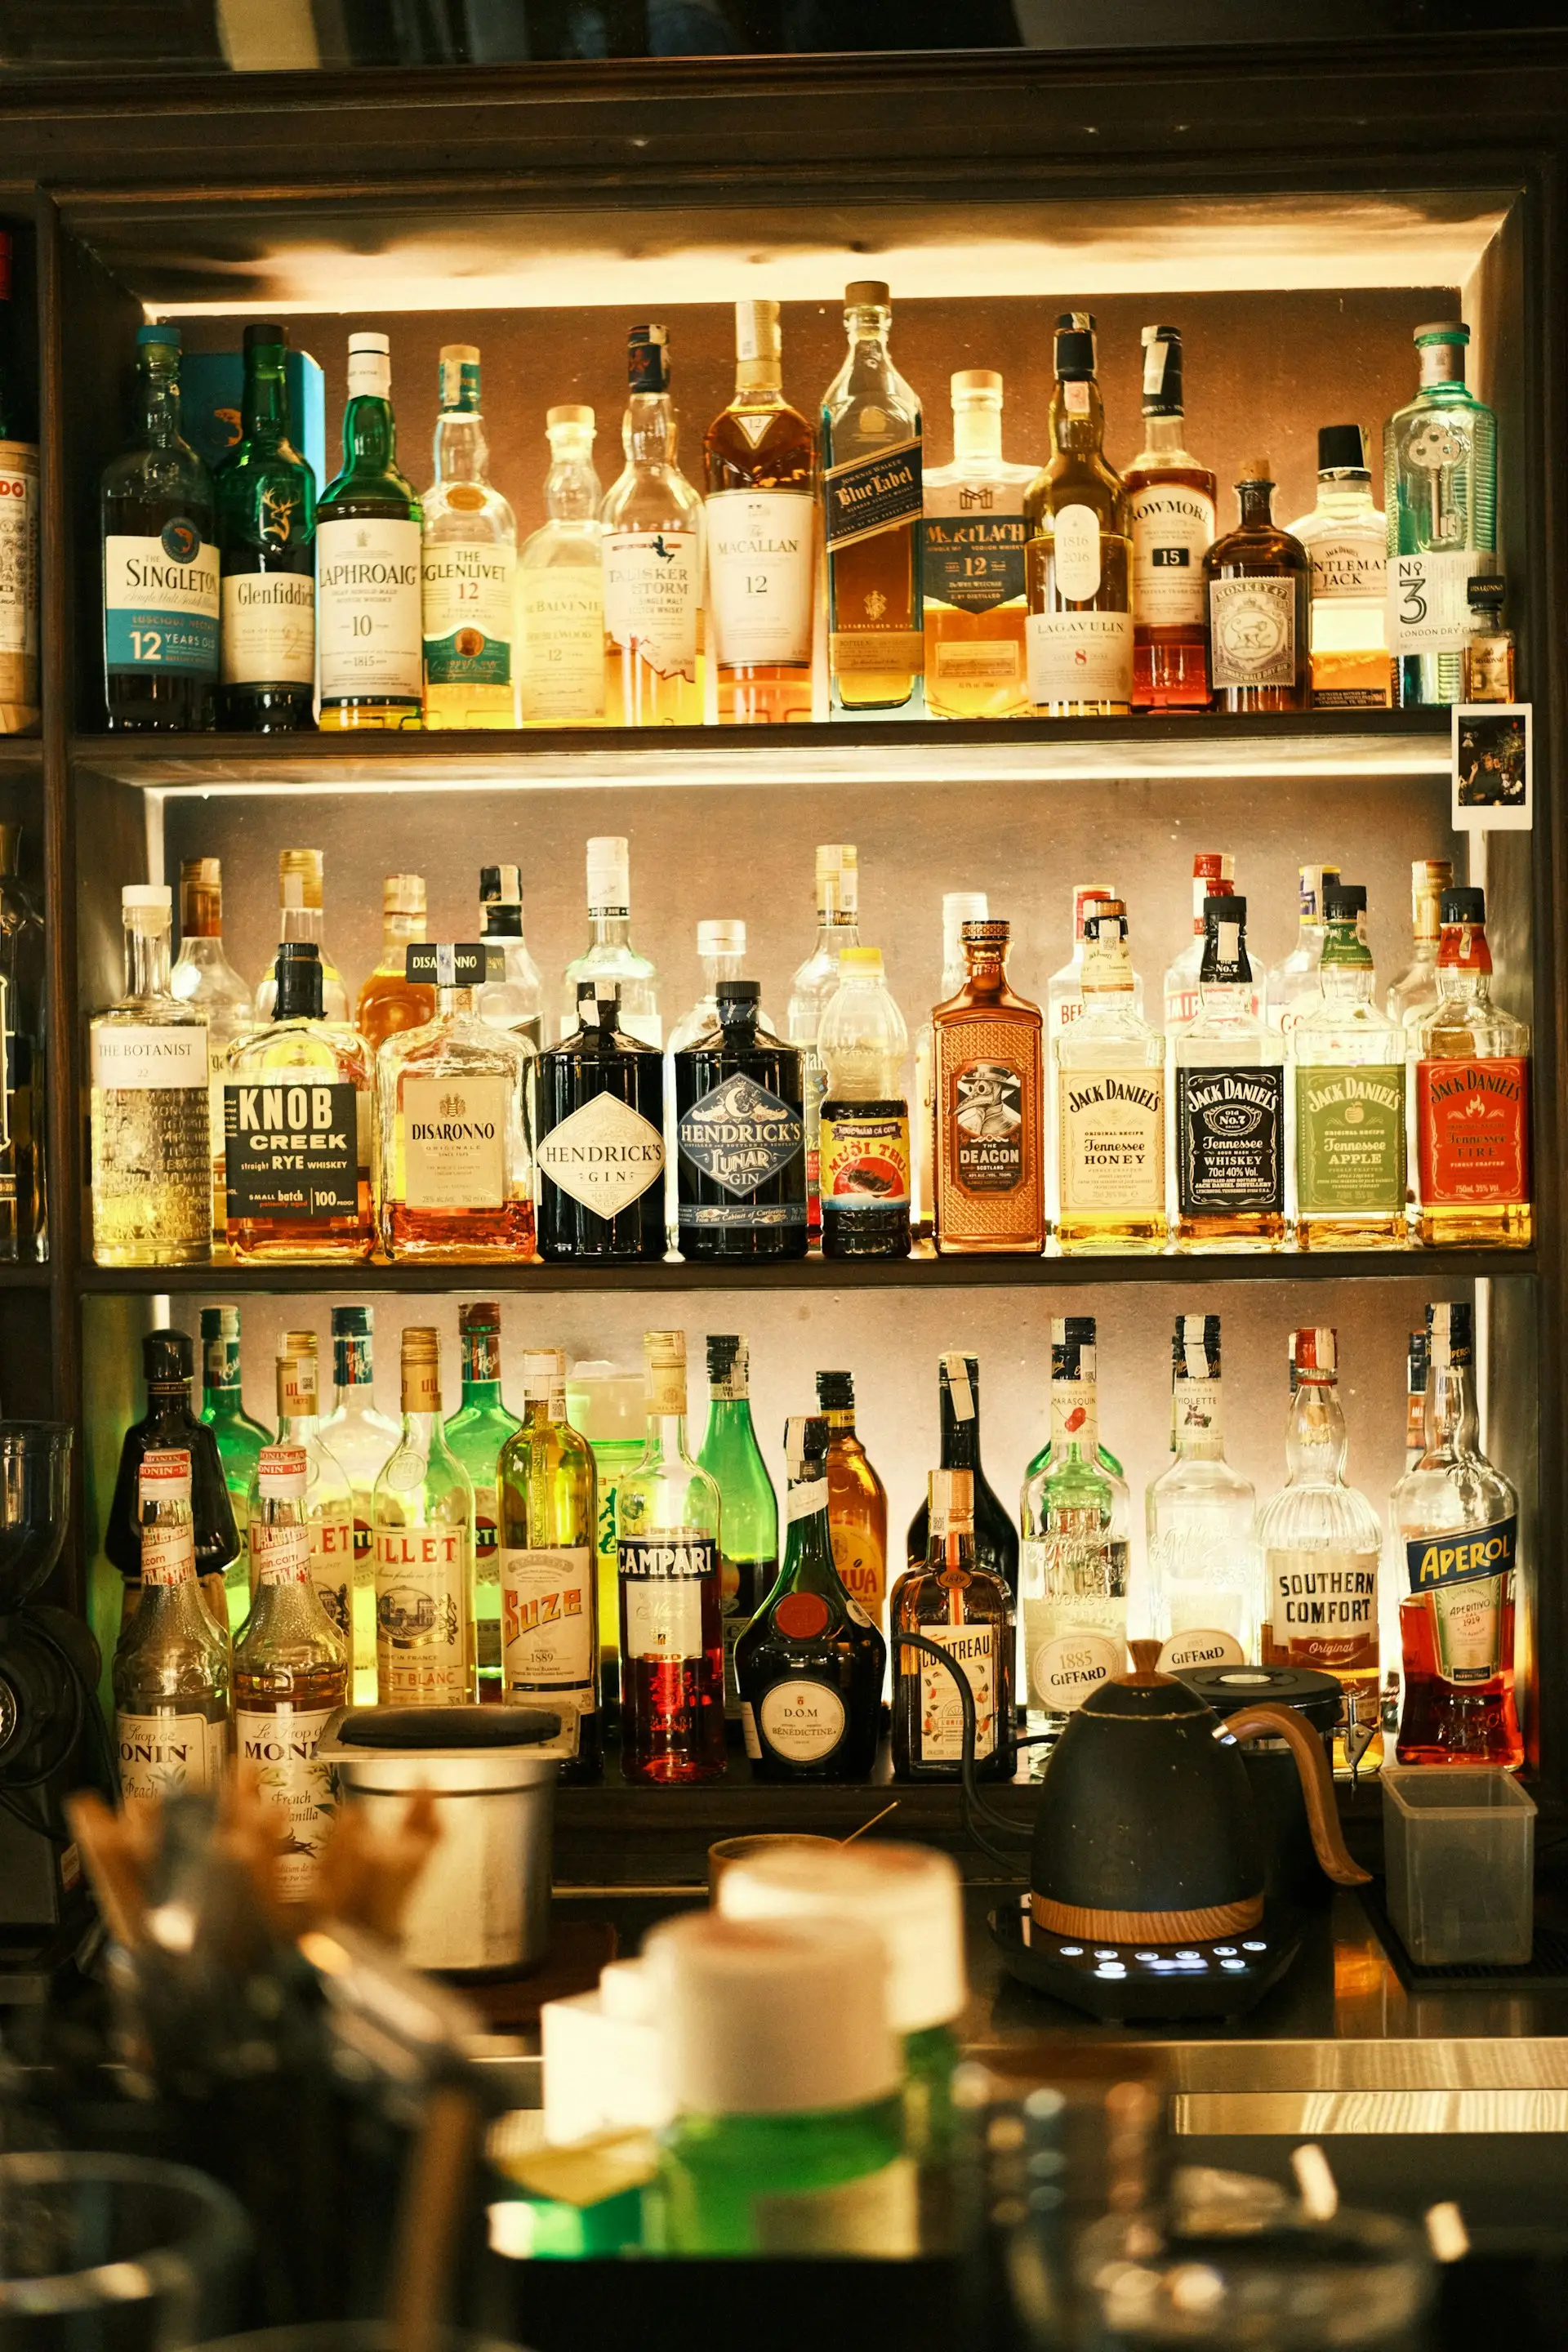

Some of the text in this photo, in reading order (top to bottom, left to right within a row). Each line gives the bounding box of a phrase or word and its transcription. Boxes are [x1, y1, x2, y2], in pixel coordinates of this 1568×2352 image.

[748, 417, 762, 429] 12
[841, 459, 902, 486] JOHNNIE WALKER
[835, 466, 913, 509] Blue Label
[717, 539, 800, 555] MACALLAN
[455, 550, 481, 562] THE
[1161, 550, 1180, 564] 15
[425, 564, 506, 582] GLENLIVET
[964, 556, 987, 577] 12
[608, 568, 688, 583] TALISKER
[1323, 572, 1363, 587] JACK
[457, 582, 479, 600] 12
[631, 581, 688, 595] STORM
[744, 575, 768, 595] 12
[1217, 582, 1287, 601] MONKEY 47
[666, 597, 683, 605] MALT
[1399, 577, 1428, 625] 3
[353, 614, 372, 637] 10
[1037, 621, 1125, 634] LAGAVULIN
[1399, 627, 1459, 638] LONDON DRY
[129, 630, 162, 661] 12
[165, 633, 199, 645] YEARS
[353, 656, 375, 667] 1815
[546, 648, 563, 662] 12
[1075, 648, 1088, 666] 8
[1263, 666, 1276, 677] DRY
[412, 956, 477, 969] DISANNO
[1215, 963, 1238, 973] No.7
[123, 1043, 193, 1057] BOTANIST
[137, 1068, 149, 1078] 22
[1429, 1069, 1523, 1104] JACK DANIEL'S
[1068, 1078, 1161, 1113] JACK DANIEL'S
[1187, 1077, 1279, 1112] JACK DANIEL'S
[1308, 1076, 1402, 1113] JACK DANIEL'S
[238, 1087, 332, 1131] KNOB
[1218, 1115, 1246, 1125] No.7
[412, 1122, 494, 1142] DISARONNO
[680, 1122, 801, 1144] HENDRICK'S
[1446, 1131, 1506, 1144] Tennessee
[249, 1134, 347, 1151] CREEK
[1084, 1138, 1145, 1152] Tennessee
[1202, 1135, 1263, 1150] Tennessee
[1324, 1138, 1387, 1152] Tennessee
[546, 1143, 662, 1163] HENDRICK'S
[879, 1143, 906, 1171] THU
[960, 1149, 1019, 1164] DEACON
[1084, 1154, 1146, 1165] HONEY
[1328, 1153, 1382, 1165] APPLE
[1458, 1147, 1498, 1157] FIRE
[241, 1156, 348, 1171] straight RYE WHISKEY
[710, 1148, 769, 1180] LUNAR
[1204, 1156, 1263, 1166] WHISKEY
[588, 1171, 626, 1183] GIN
[729, 1173, 760, 1184] GIN
[1208, 1166, 1258, 1178] 70cl 40% Vol.
[278, 1190, 303, 1201] batch
[1455, 1184, 1474, 1193] 750mL
[1475, 1184, 1489, 1192] 35%
[314, 1191, 336, 1206] 100
[722, 1212, 746, 1221] Cabinet
[747, 1210, 755, 1219] of
[1178, 1396, 1217, 1405] VIOLETTE
[618, 1546, 712, 1575] CAMPARI
[1419, 1535, 1510, 1584] APEROL
[1279, 1572, 1374, 1597] SOUTHERN
[1285, 1598, 1371, 1624] COMFORT
[1450, 1598, 1490, 1616] APERITIVO
[1463, 1616, 1481, 1627] 1919
[1171, 1646, 1225, 1664] GIFFARD
[1308, 1642, 1356, 1656] Original
[408, 1653, 438, 1661] FRANCE
[530, 1653, 554, 1664] 1889
[1060, 1650, 1093, 1669] 1885
[408, 1672, 456, 1686] BLANC
[1050, 1666, 1107, 1686] GIFFARD
[252, 1722, 271, 1740] Le
[125, 1775, 158, 1798] Peach
[271, 1788, 311, 1806] French
[284, 1807, 318, 1823] anilla
